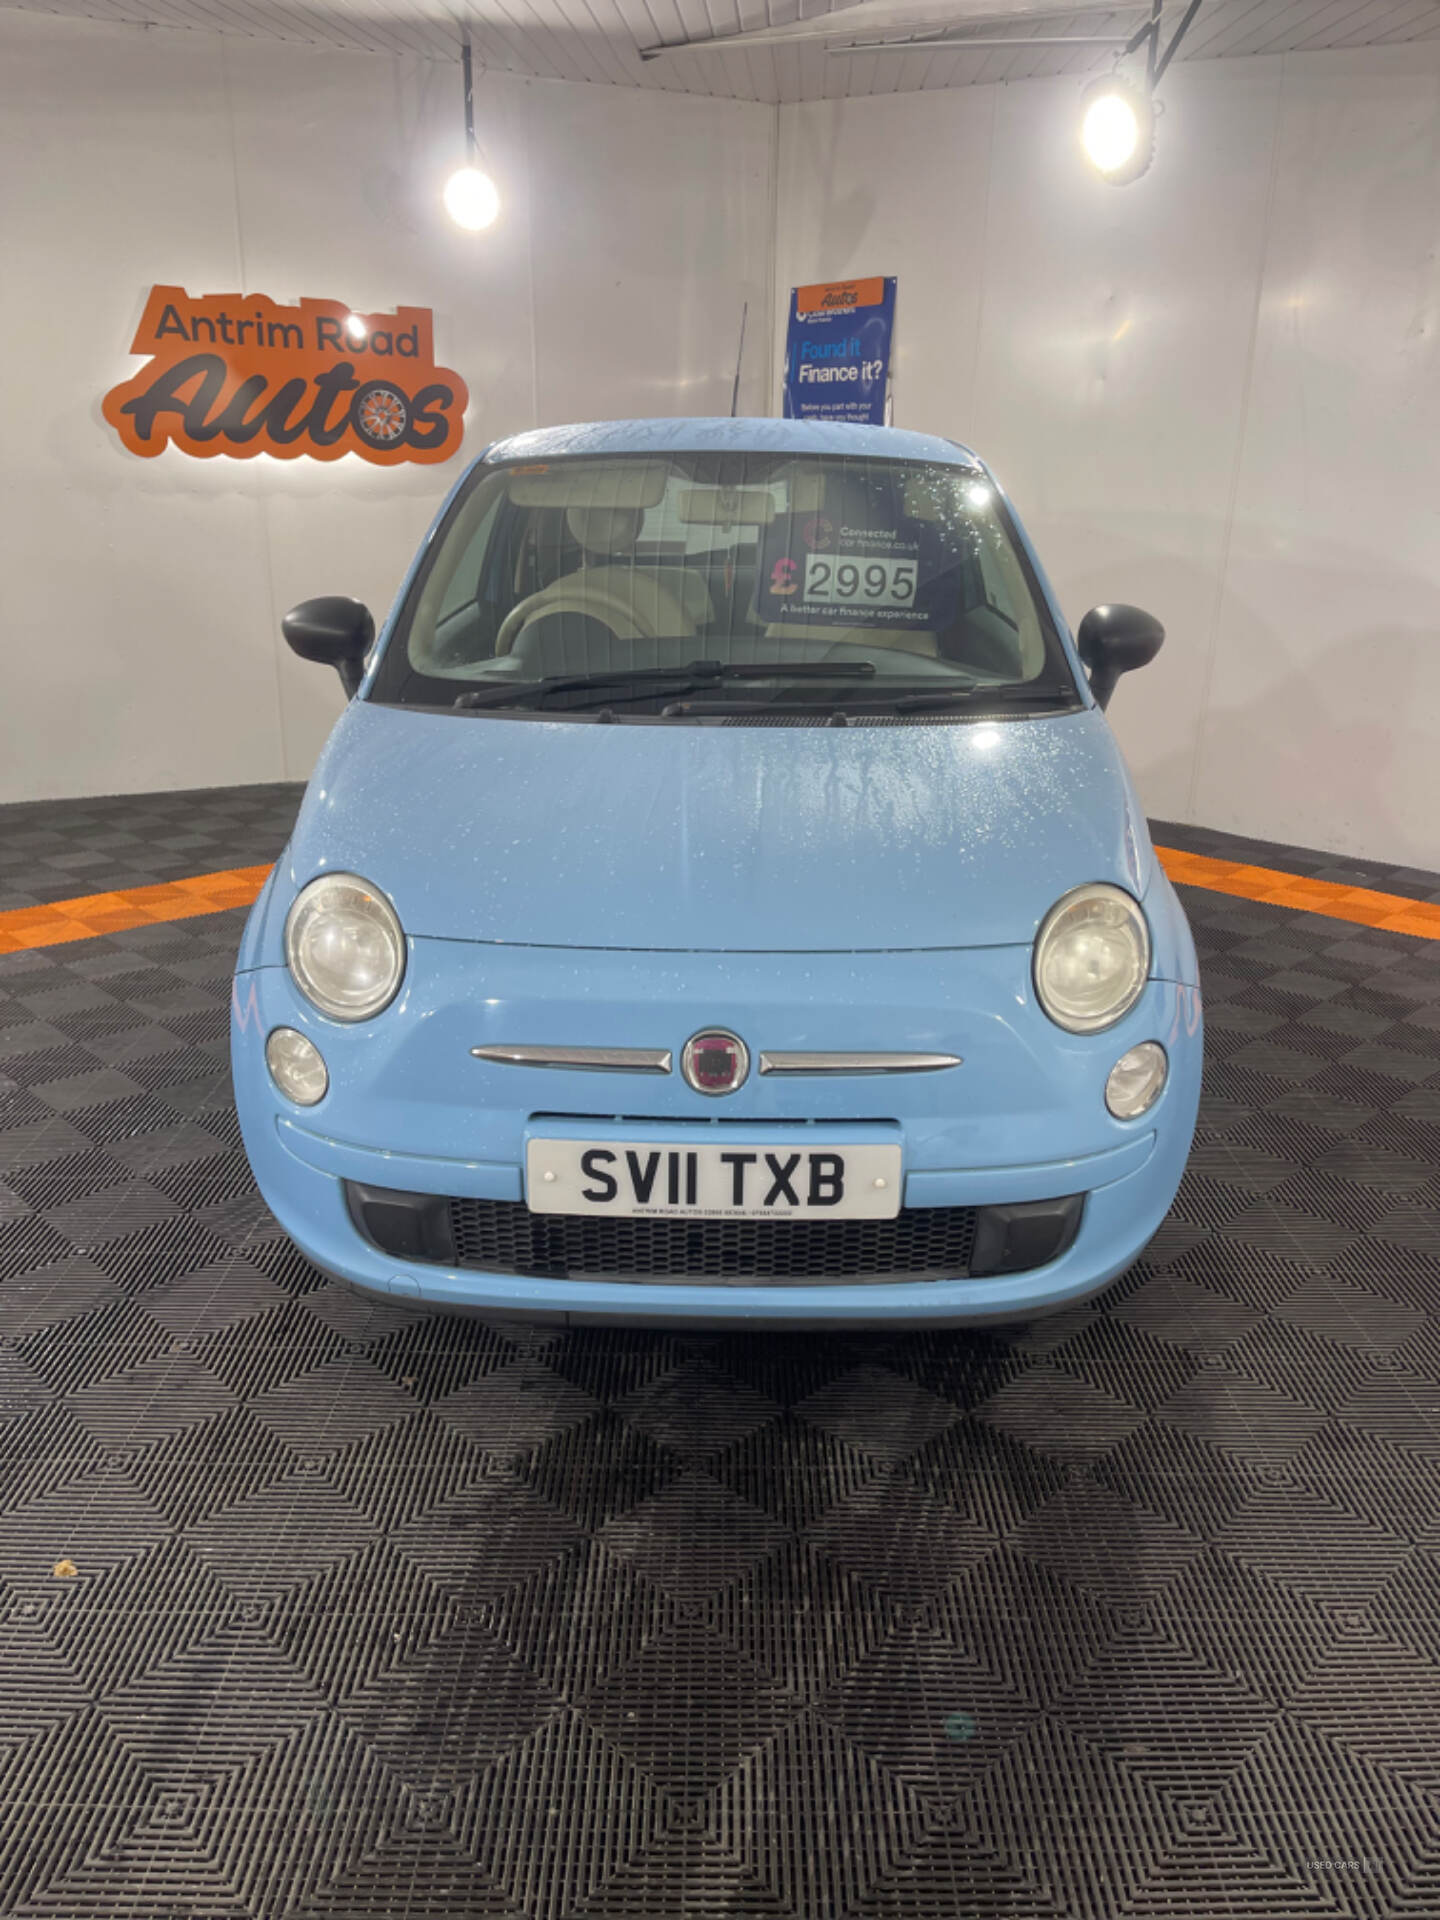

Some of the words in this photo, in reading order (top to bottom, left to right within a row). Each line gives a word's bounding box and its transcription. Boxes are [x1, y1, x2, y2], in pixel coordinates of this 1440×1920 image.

[155, 304, 304, 349] Antrim
[316, 315, 419, 358] Road
[801, 338, 847, 360] Found
[850, 336, 861, 357] it
[799, 364, 858, 383] Finance
[861, 360, 883, 380] it?
[120, 353, 454, 451] Autos
[840, 527, 896, 540] Connected
[780, 604, 788, 613] A
[791, 605, 819, 615] better
[822, 607, 837, 616] car
[839, 606, 874, 618] finance
[877, 609, 929, 620] experience
[580, 1148, 698, 1205] SV11
[720, 1152, 845, 1207] TXB
